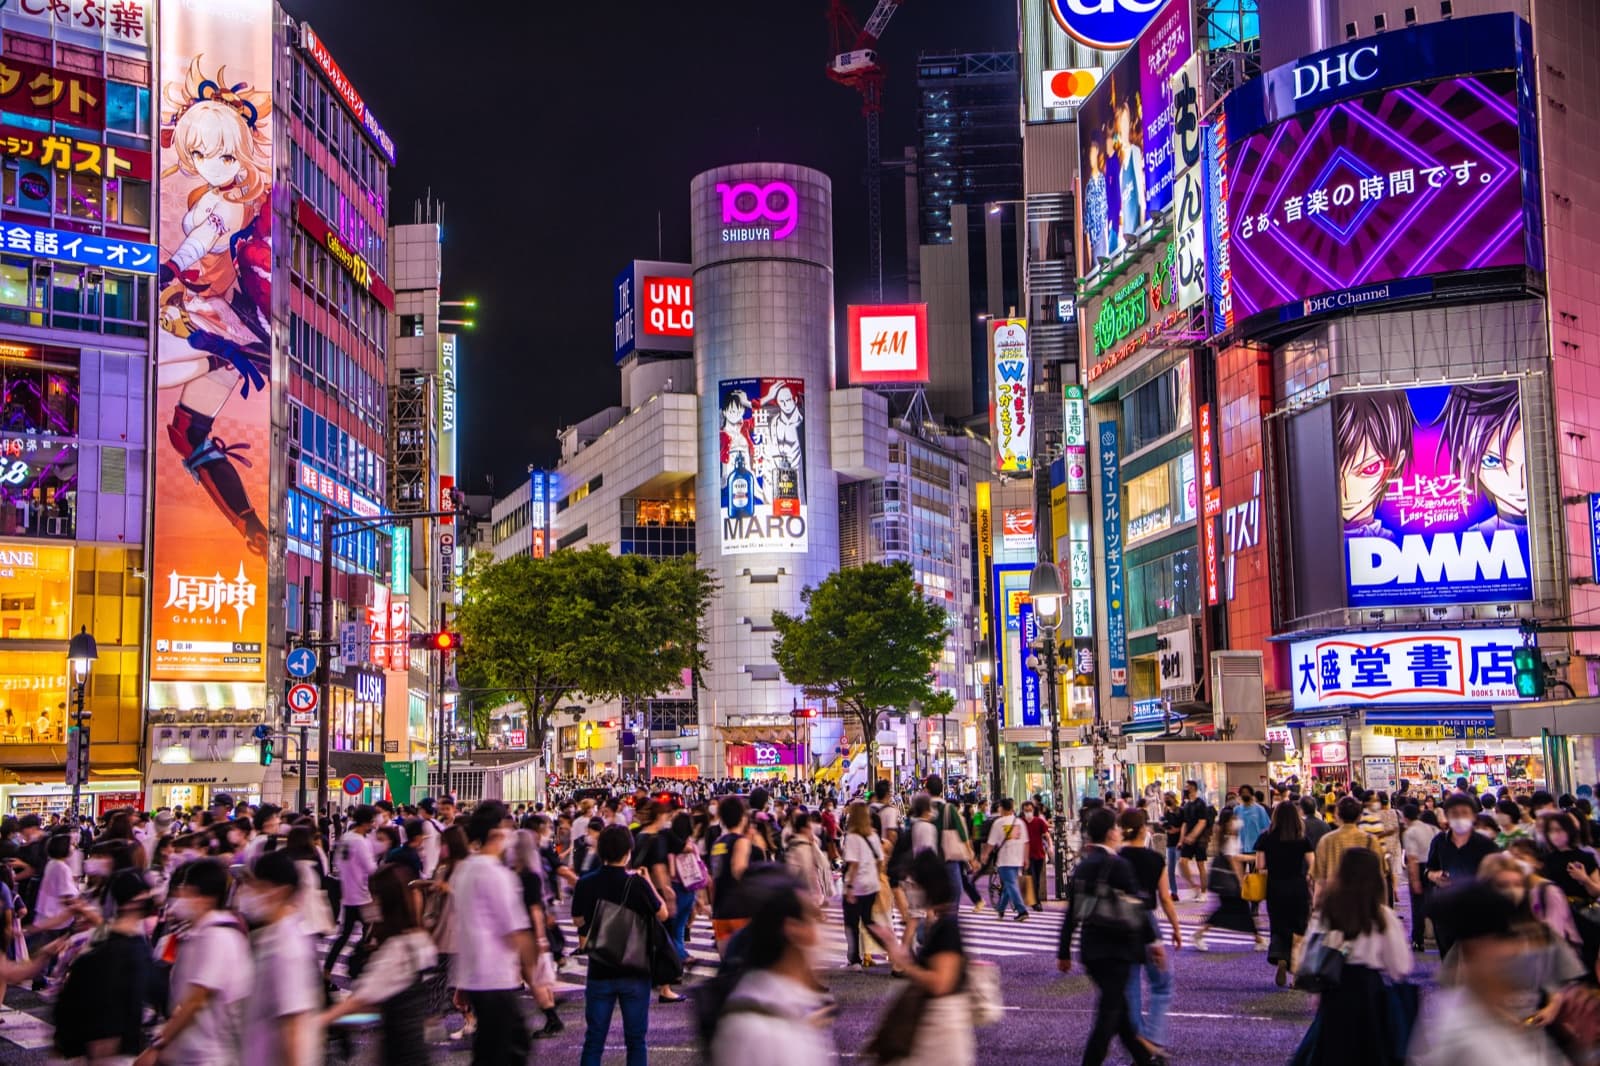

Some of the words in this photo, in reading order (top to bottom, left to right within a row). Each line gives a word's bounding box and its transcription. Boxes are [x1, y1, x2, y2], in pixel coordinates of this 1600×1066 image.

[1292, 45, 1379, 101] DHC
[1053, 97, 1083, 106] masterc
[1147, 119, 1157, 140] THE
[1157, 107, 1170, 133] BEAT
[40, 136, 131, 179] ガスト
[1173, 71, 1205, 293] もんじゃ
[716, 181, 798, 240] 109
[1241, 160, 1493, 240] さあ、音楽の時間です。
[722, 228, 770, 242] SHIBUYA
[618, 278, 630, 315] THE
[650, 283, 691, 304] UNI
[1308, 294, 1335, 313] DHC
[1337, 285, 1390, 307] Channel
[615, 308, 634, 352] PRIME
[650, 309, 693, 331] QLO
[443, 342, 453, 366] BIC
[870, 330, 907, 356] H&M
[1384, 473, 1473, 498] コードギアス
[723, 515, 806, 541] MARO
[1103, 451, 1121, 594] サマーフルーツギフト
[1226, 470, 1261, 600] クスリ
[1348, 529, 1528, 585] DMM
[163, 560, 256, 633] 原神
[172, 615, 227, 625] Genshin
[1025, 612, 1033, 648] MIZUH
[1299, 641, 1515, 695] 大盛堂書店
[357, 672, 382, 704] LUSH
[1471, 688, 1494, 698] BOOKS
[1496, 688, 1517, 697] TAISE
